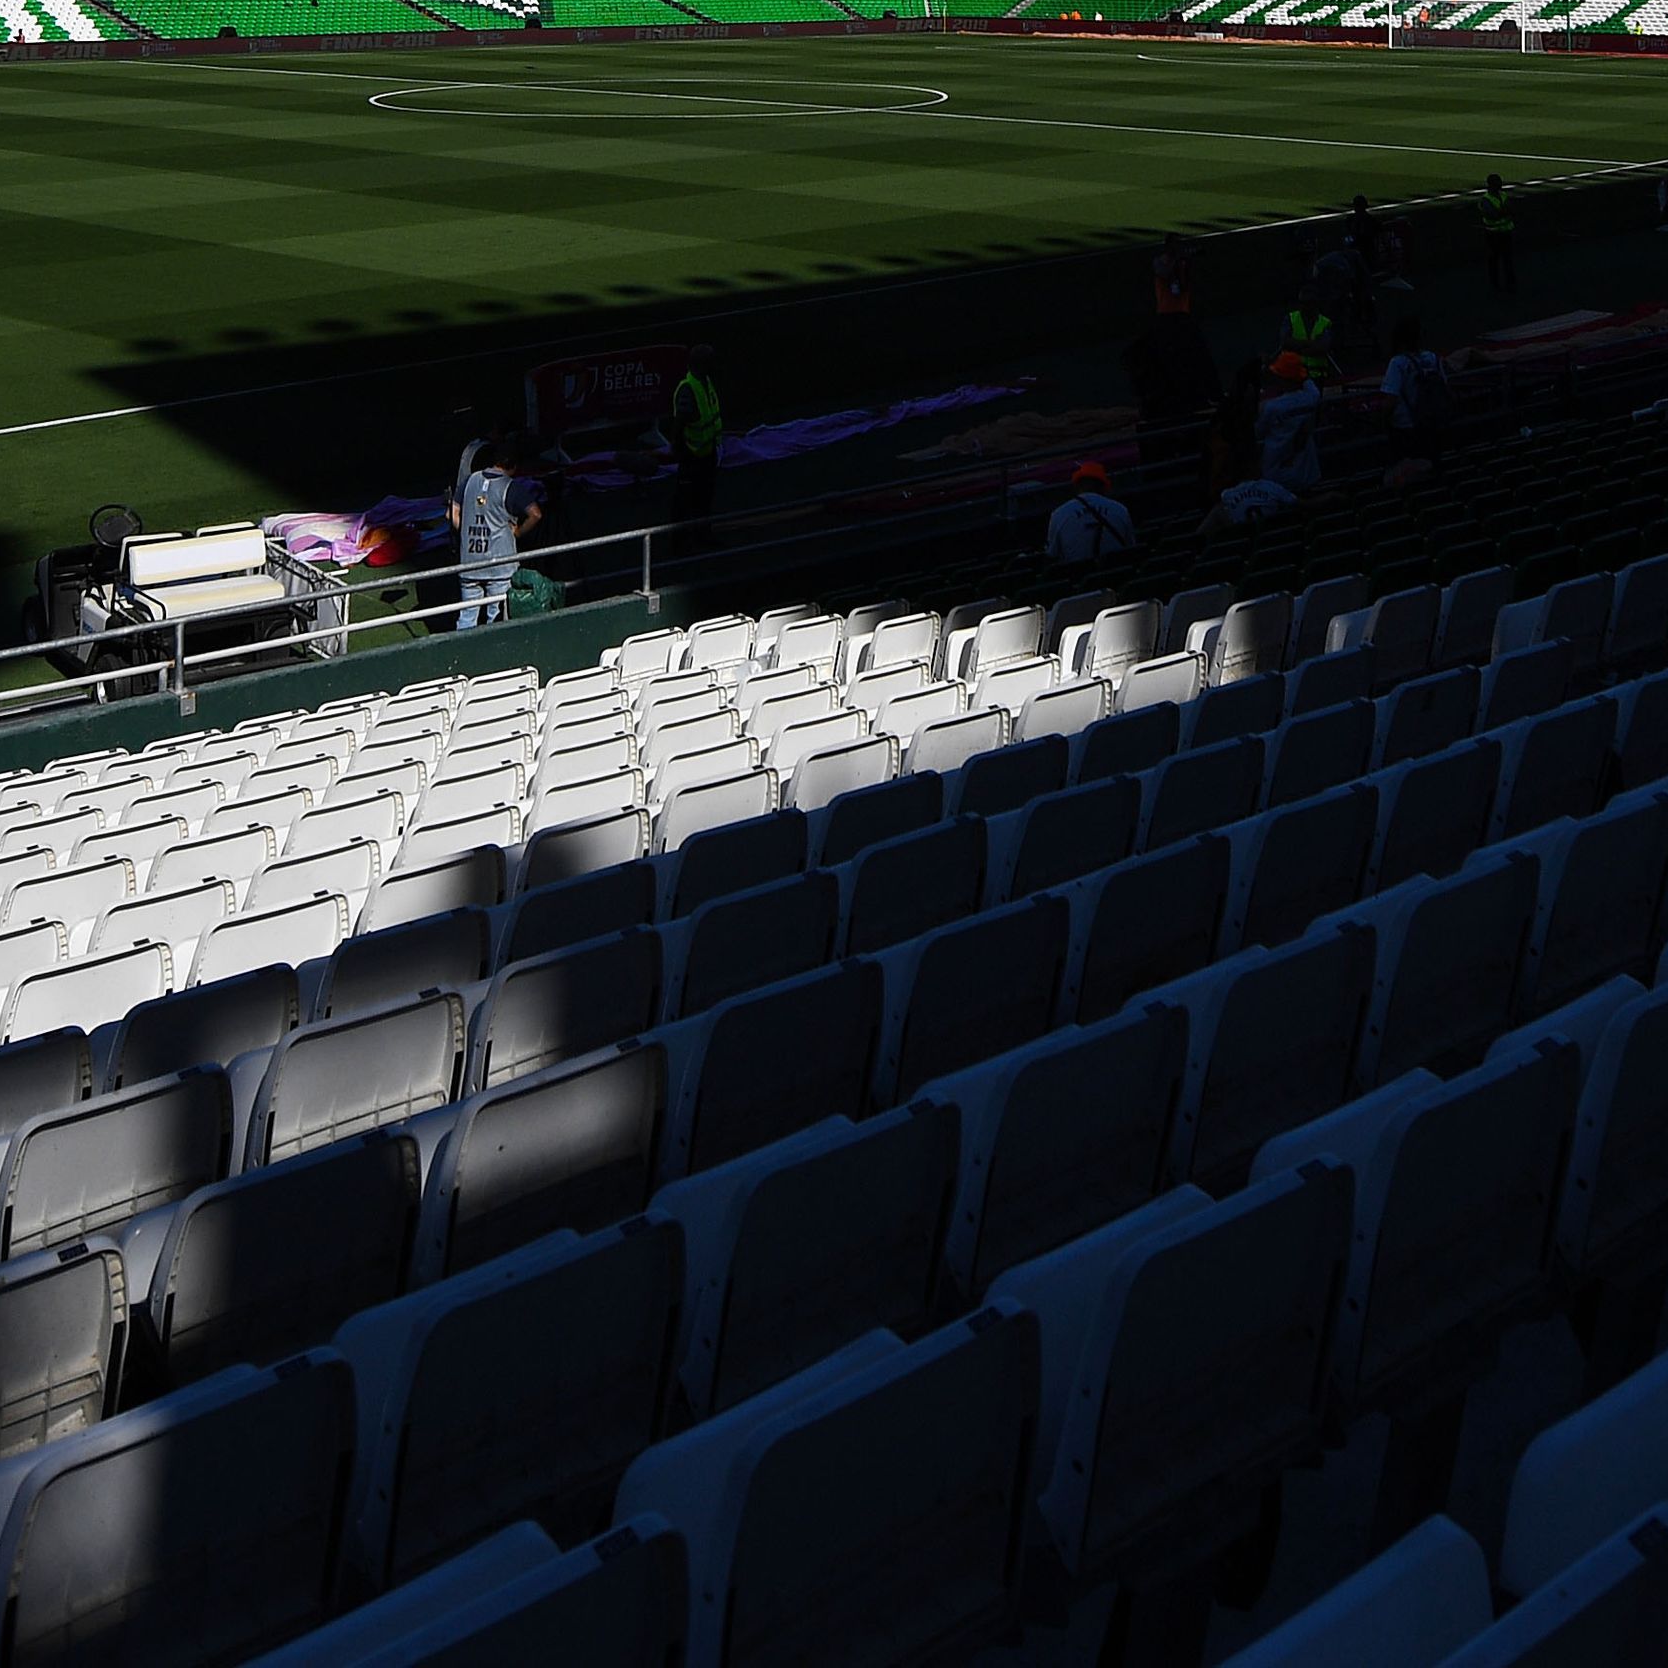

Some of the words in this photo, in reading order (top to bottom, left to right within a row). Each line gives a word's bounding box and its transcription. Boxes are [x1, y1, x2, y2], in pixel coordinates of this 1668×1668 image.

[694, 25, 730, 38] 2019
[952, 19, 989, 31] 2019
[319, 36, 387, 51] FINAL
[392, 33, 437, 47] 2019
[50, 43, 106, 59] 2019
[604, 361, 645, 377] COPA
[604, 377, 631, 392] DEL
[634, 373, 661, 388] REY
[475, 514, 486, 525] TV
[468, 526, 491, 537] PHOTO
[468, 539, 489, 554] 267
